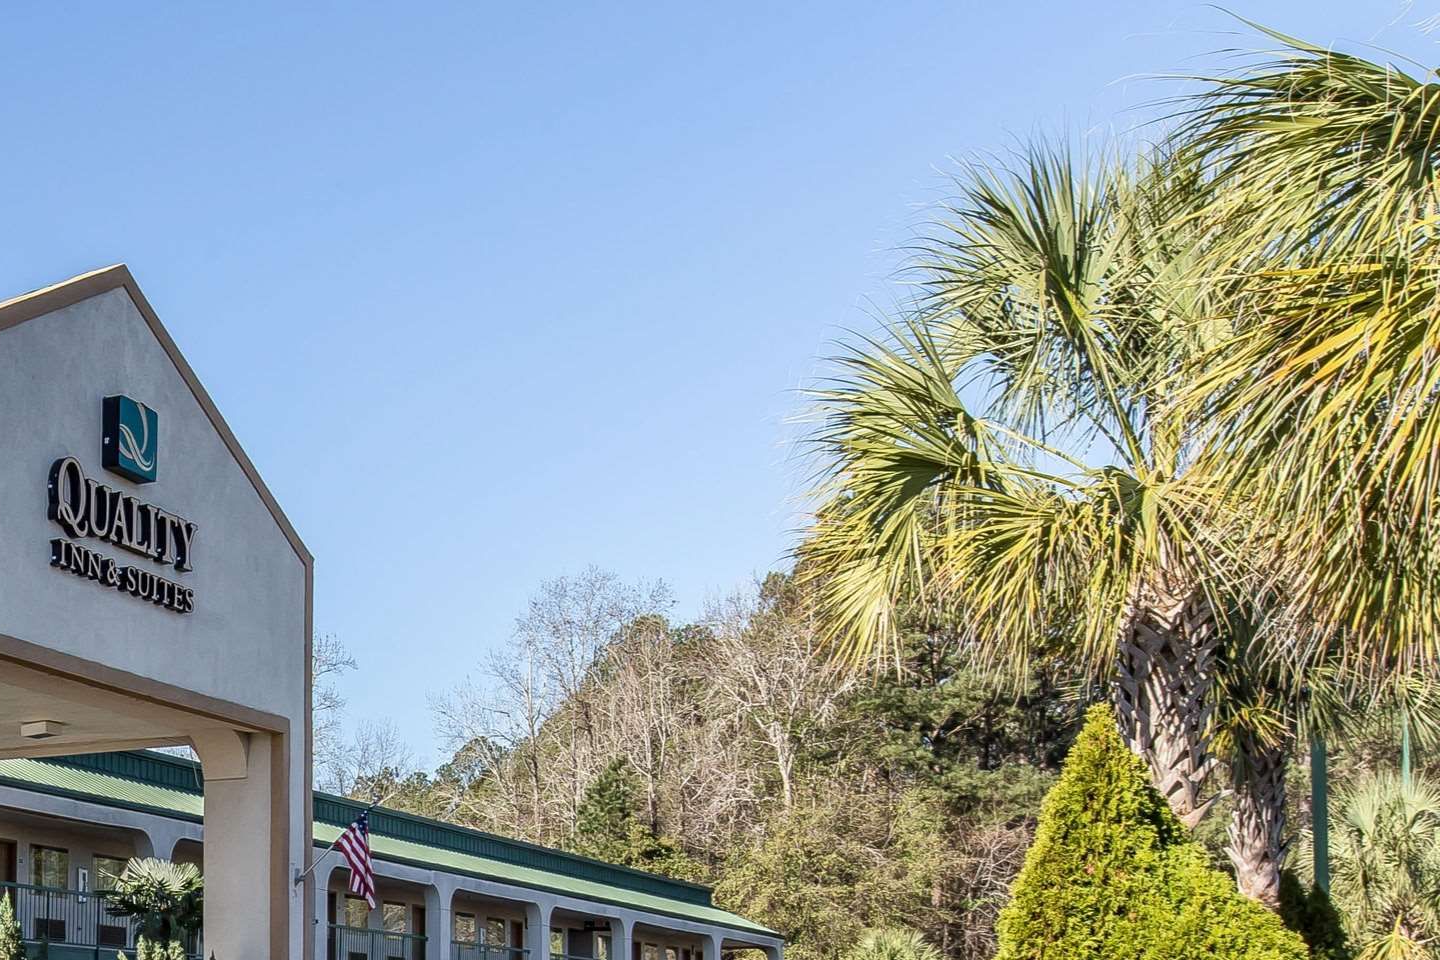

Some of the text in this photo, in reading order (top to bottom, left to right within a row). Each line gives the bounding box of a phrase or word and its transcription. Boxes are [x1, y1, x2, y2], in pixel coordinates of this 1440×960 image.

[56, 456, 199, 572] QUALITY
[58, 538, 196, 614] INN & SUITES
